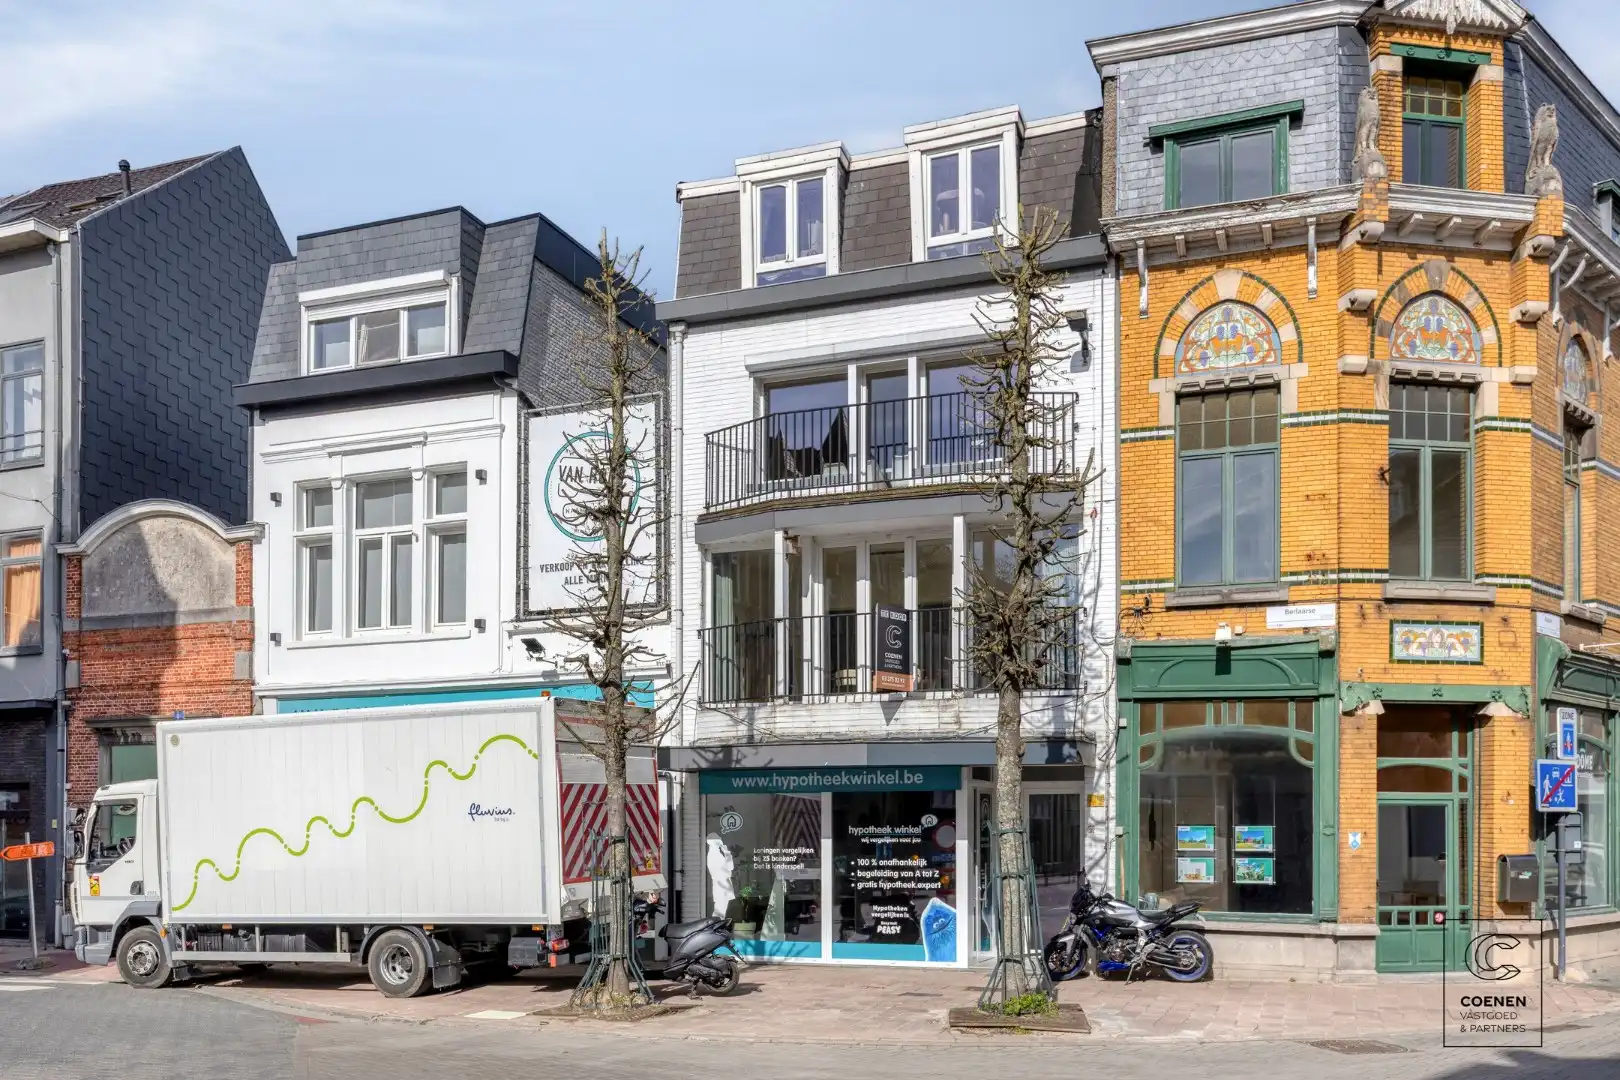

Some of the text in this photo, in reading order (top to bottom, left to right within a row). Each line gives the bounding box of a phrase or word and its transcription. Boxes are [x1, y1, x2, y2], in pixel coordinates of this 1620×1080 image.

[559, 465, 583, 483] VAN
[540, 561, 574, 573] VERKOOP
[564, 575, 584, 585] ALLE
[1284, 607, 1316, 615] Berlaarse
[1561, 711, 1574, 720] ZONE
[731, 769, 924, 790] www.hypotheekwinkel.be
[782, 847, 815, 855] vergelijken
[772, 863, 805, 871] kinderspel!
[857, 858, 870, 866] 100
[879, 858, 928, 868] onafhankelijk
[857, 869, 899, 878] begeleiding
[922, 870, 932, 878] tot
[857, 880, 941, 890] gratis hypotheek.expert
[871, 911, 904, 919] vergelijken
[876, 925, 901, 935] PEASY
